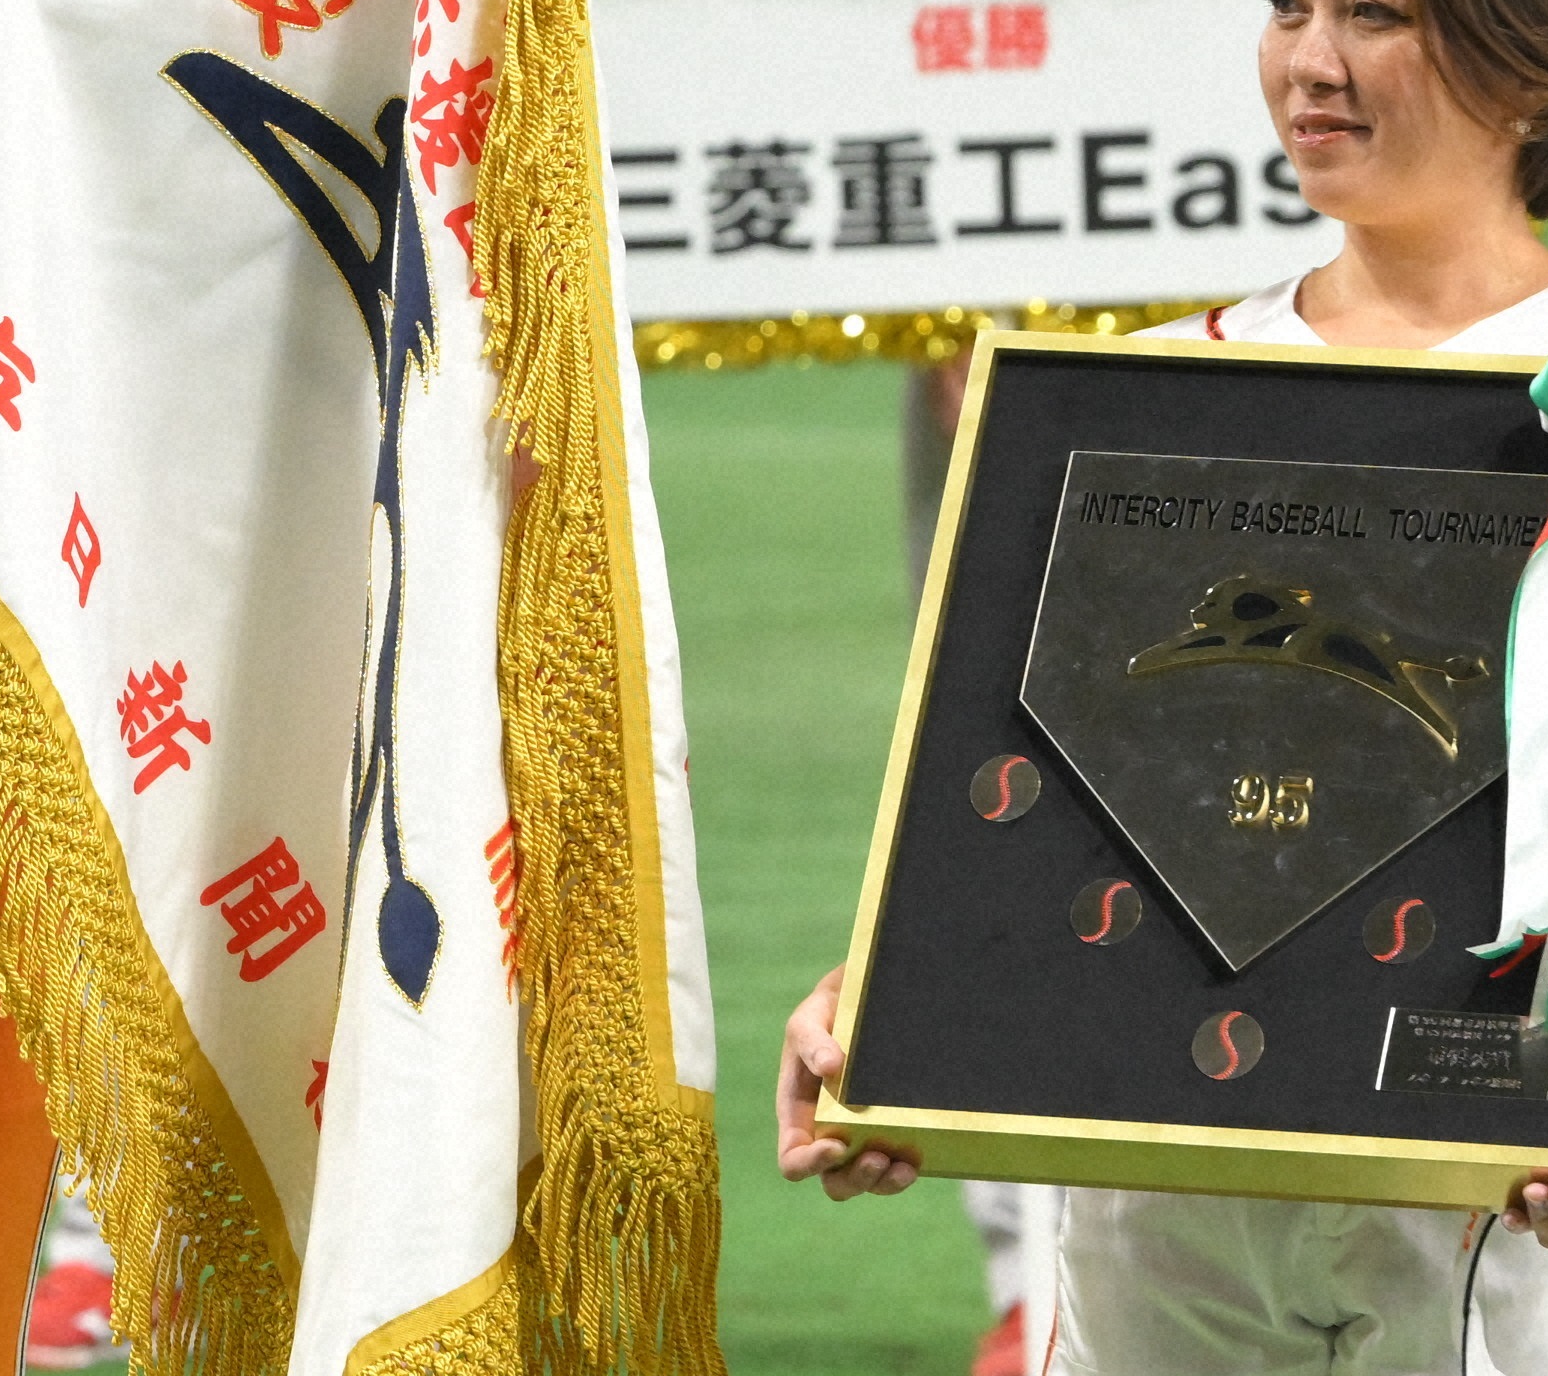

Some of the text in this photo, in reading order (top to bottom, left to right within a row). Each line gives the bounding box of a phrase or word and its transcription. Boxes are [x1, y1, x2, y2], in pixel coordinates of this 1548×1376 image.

[910, 3, 1050, 73] 優勝
[1079, 490, 1547, 549] INTERCITY BASEBALL TOURNAME
[1226, 773, 1315, 832] 95
